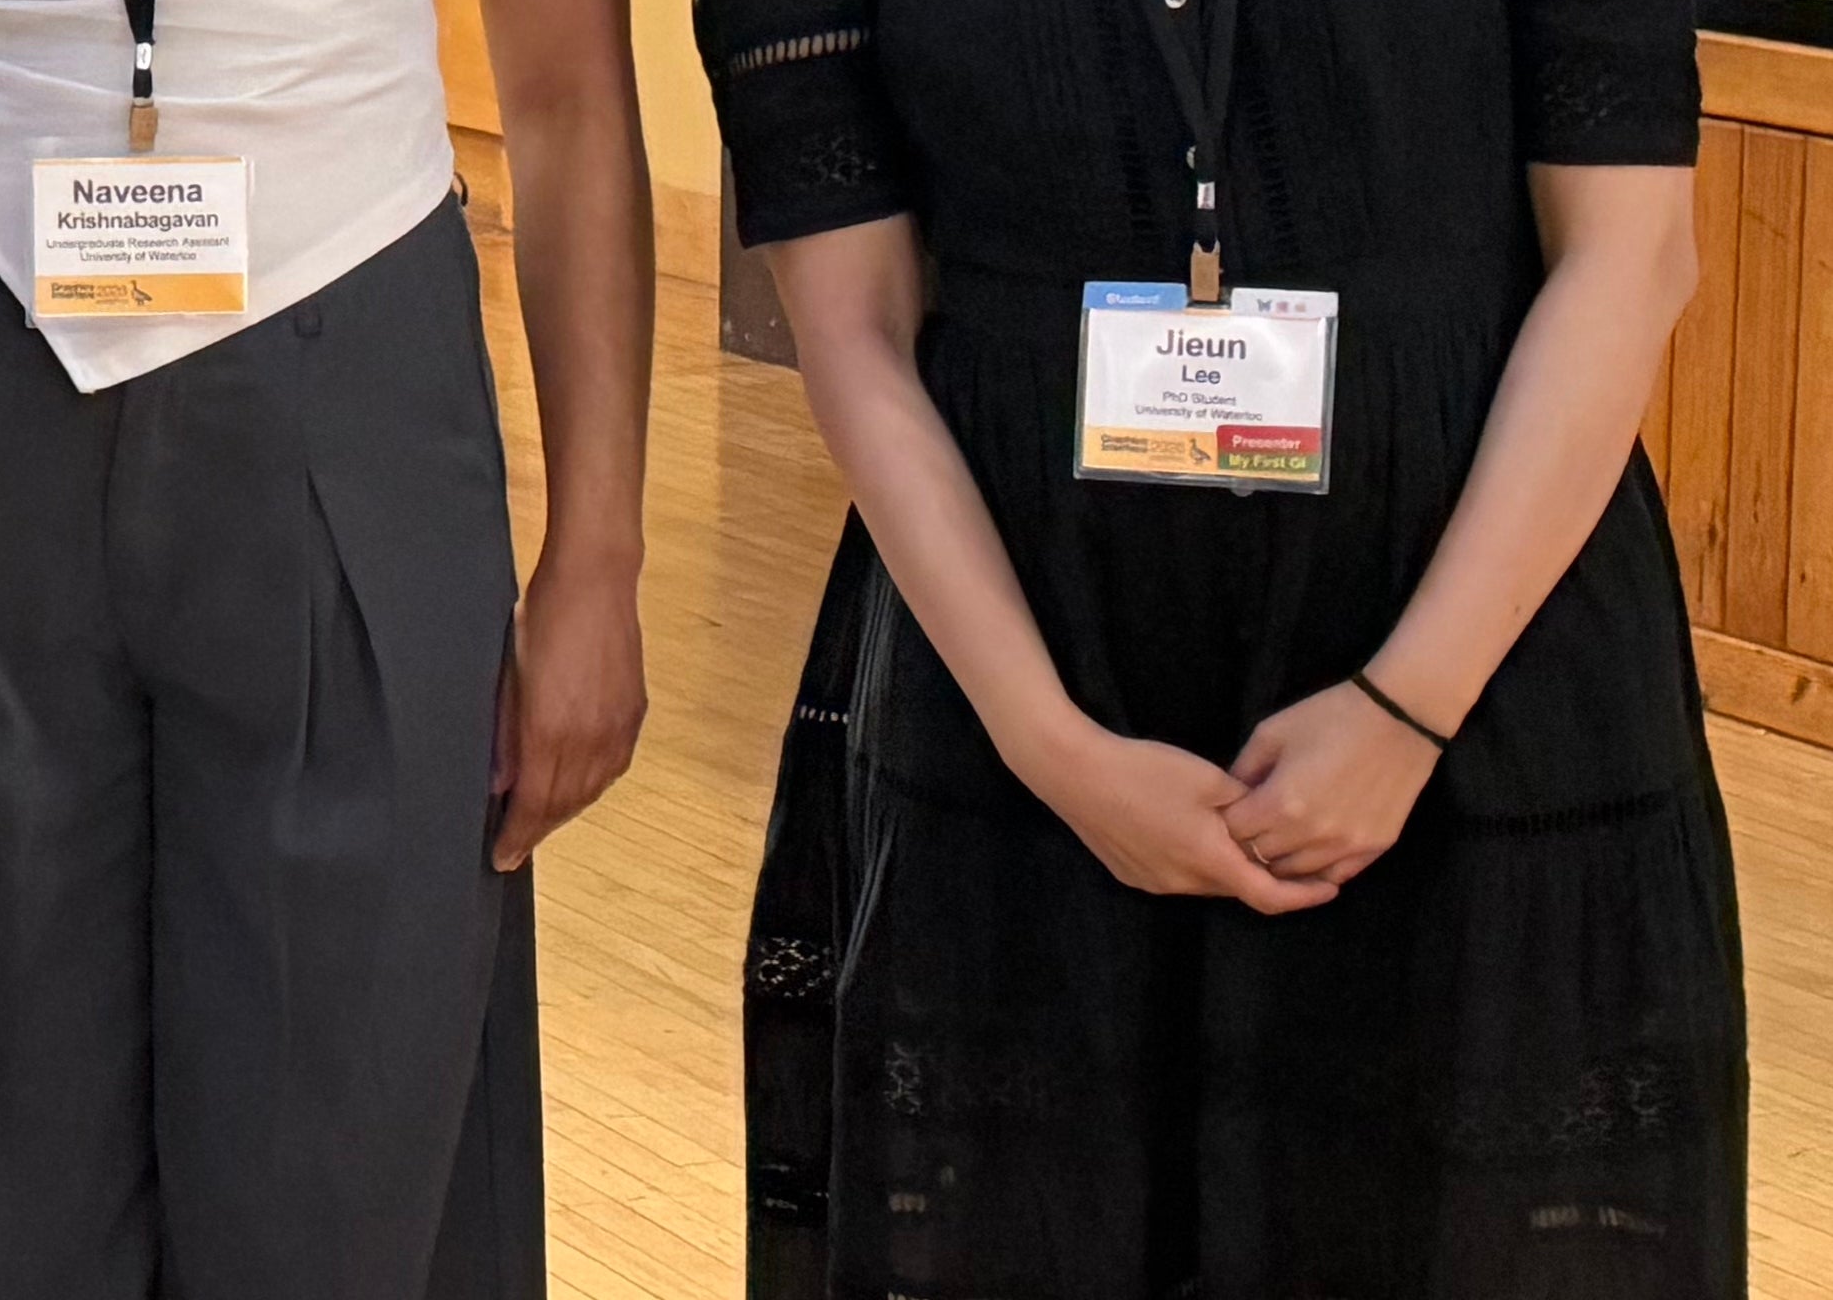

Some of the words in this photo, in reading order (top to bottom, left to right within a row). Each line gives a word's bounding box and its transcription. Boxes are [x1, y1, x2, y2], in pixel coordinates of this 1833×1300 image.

[73, 179, 202, 204] Naveena
[58, 212, 218, 232] Krishnabagavan
[129, 238, 178, 248] Research
[80, 252, 131, 263] University
[135, 251, 147, 261] of
[149, 251, 196, 261] Waterloo
[1156, 329, 1246, 359] Jieun
[1181, 365, 1221, 384] Lee
[1163, 392, 1187, 403] PhD
[1192, 393, 1236, 406] Student
[1136, 405, 1192, 418] University
[1196, 407, 1207, 418] of
[1211, 409, 1263, 421] Waterloo
[1232, 435, 1301, 449] Presenter
[1229, 453, 1250, 468] My
[1254, 454, 1285, 467] First
[1290, 458, 1306, 469] GI
